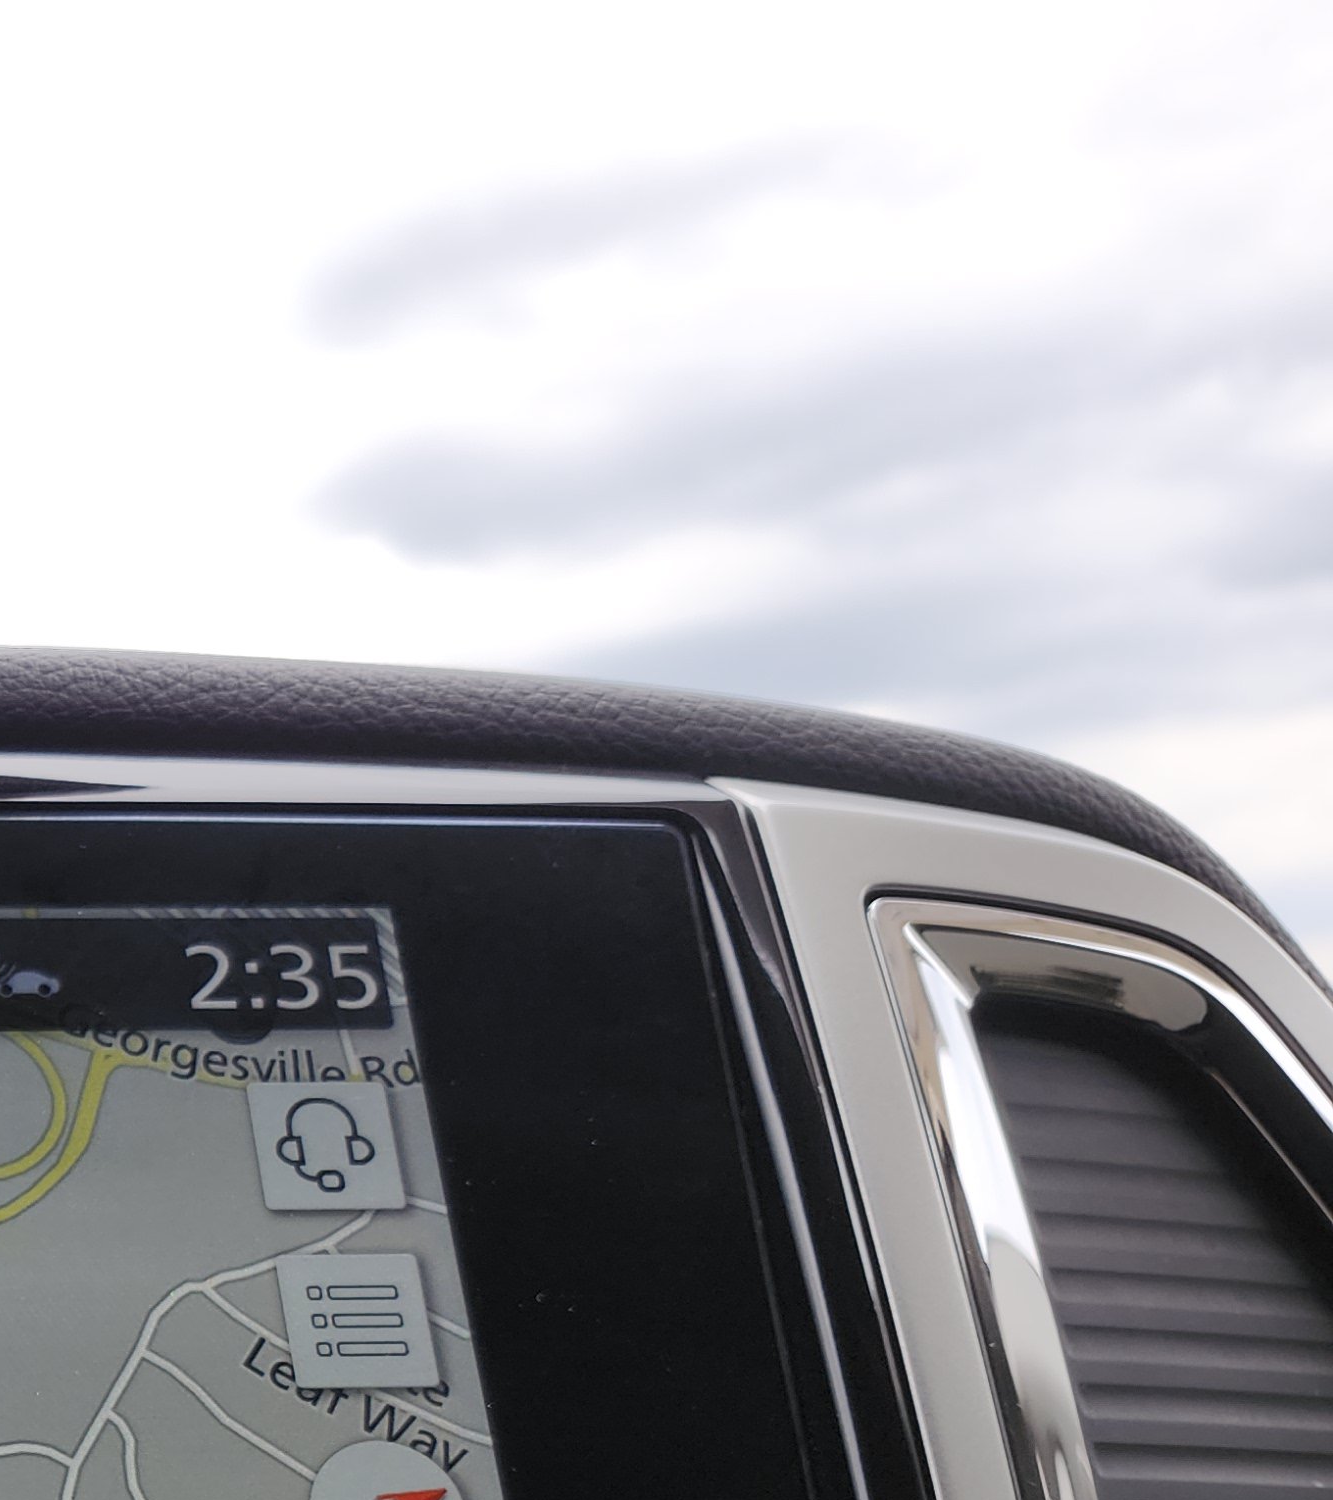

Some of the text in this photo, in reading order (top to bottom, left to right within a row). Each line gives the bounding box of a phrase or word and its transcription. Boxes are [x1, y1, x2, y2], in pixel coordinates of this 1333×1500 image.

[185, 942, 379, 1011] 2:35
[360, 1048, 422, 1088] Rd
[363, 1394, 469, 1473] Way
